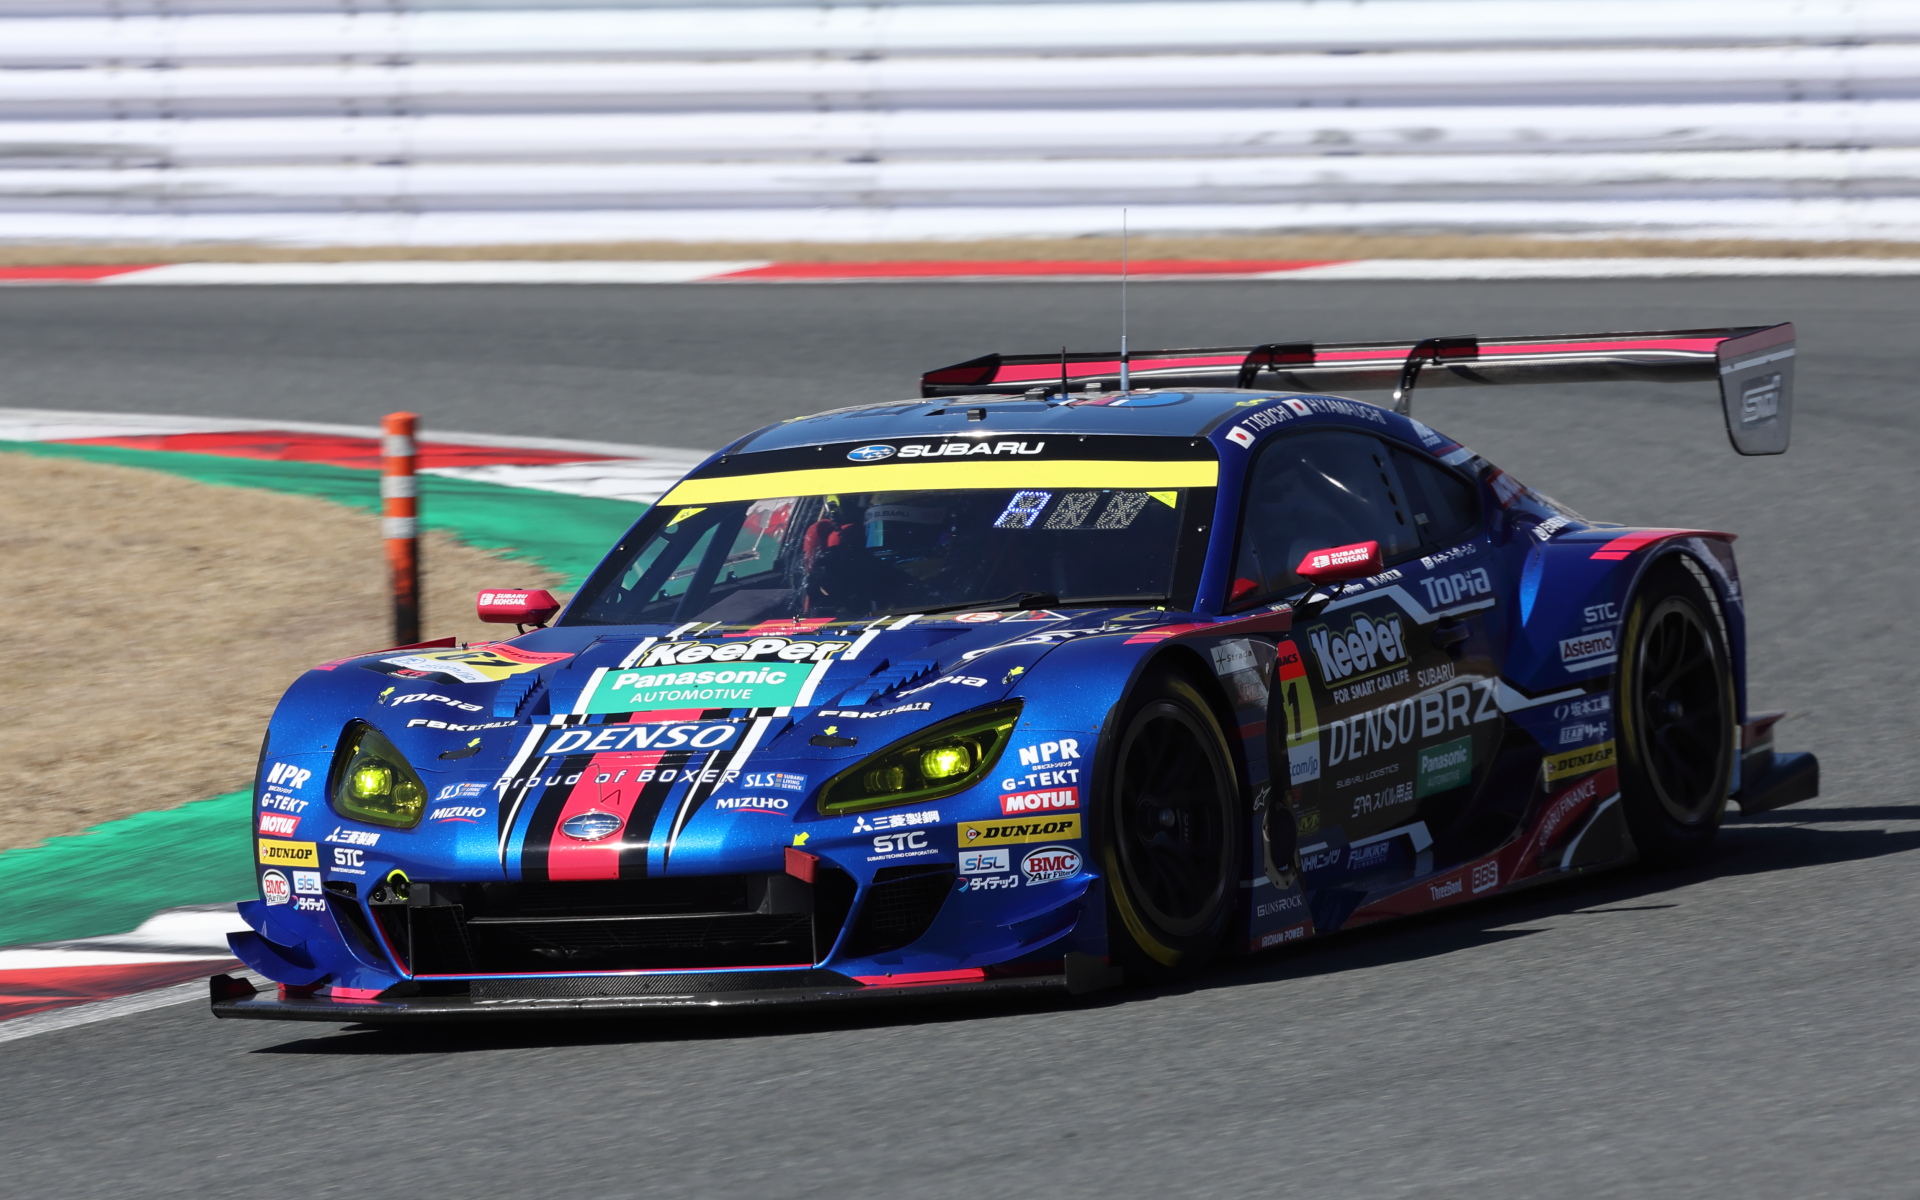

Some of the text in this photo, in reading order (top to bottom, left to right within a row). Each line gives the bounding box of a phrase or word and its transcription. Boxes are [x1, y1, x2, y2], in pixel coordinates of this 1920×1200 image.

[897, 441, 1046, 458] SUBARU
[1330, 547, 1368, 559] SUBARU
[1332, 552, 1369, 566] KOHSAN
[493, 598, 526, 606] KOHSAN
[1583, 602, 1619, 623] STC
[641, 638, 847, 667] KeePer
[1310, 612, 1408, 683] KeePer
[1564, 636, 1612, 660] Astemo
[611, 666, 788, 691] Panasonic
[1417, 662, 1456, 688] SUBARU
[629, 688, 752, 703] AUTOMOTIVE
[1333, 669, 1410, 704] FOR SMART CAR LIFE
[817, 710, 880, 719] FBK
[1328, 680, 1499, 767] DENSO BRZ
[406, 719, 466, 732] FBK
[544, 725, 737, 755] DENSO
[1018, 738, 1081, 766] NPR
[1421, 745, 1467, 774] Panasonic
[1558, 748, 1613, 771] DUNLOP
[266, 762, 312, 789] NPR
[492, 769, 741, 791] Proud of BOXER
[744, 773, 776, 787] SLS
[1001, 768, 1080, 791] G-TEKT
[1365, 763, 1400, 781] LOGISTICS
[435, 783, 465, 801] SLS
[781, 783, 802, 791] SERVICE
[261, 793, 309, 813] G-TEKT
[715, 797, 789, 810] MIZUHO
[1006, 790, 1076, 812] MOTUL
[1559, 780, 1597, 817] FINANCE
[429, 806, 487, 820] MIZUHO
[872, 810, 940, 831] 三菱製鋼
[260, 815, 297, 834] MOTUL
[983, 821, 1073, 839] DUNLOP
[873, 830, 928, 853] STC
[269, 847, 313, 860] DUNLOP
[334, 848, 365, 867] STC
[867, 849, 939, 862] SUBARU TECHNO CORPORATION
[1028, 854, 1075, 873] BMC
[969, 874, 1019, 891] ダイテック
[1030, 870, 1073, 882] Air Filter
[1472, 860, 1499, 889] BBS
[265, 879, 287, 895] BMC
[1257, 894, 1303, 917] GUNSROCK
[1261, 926, 1304, 947] IRIDIUM POWER
